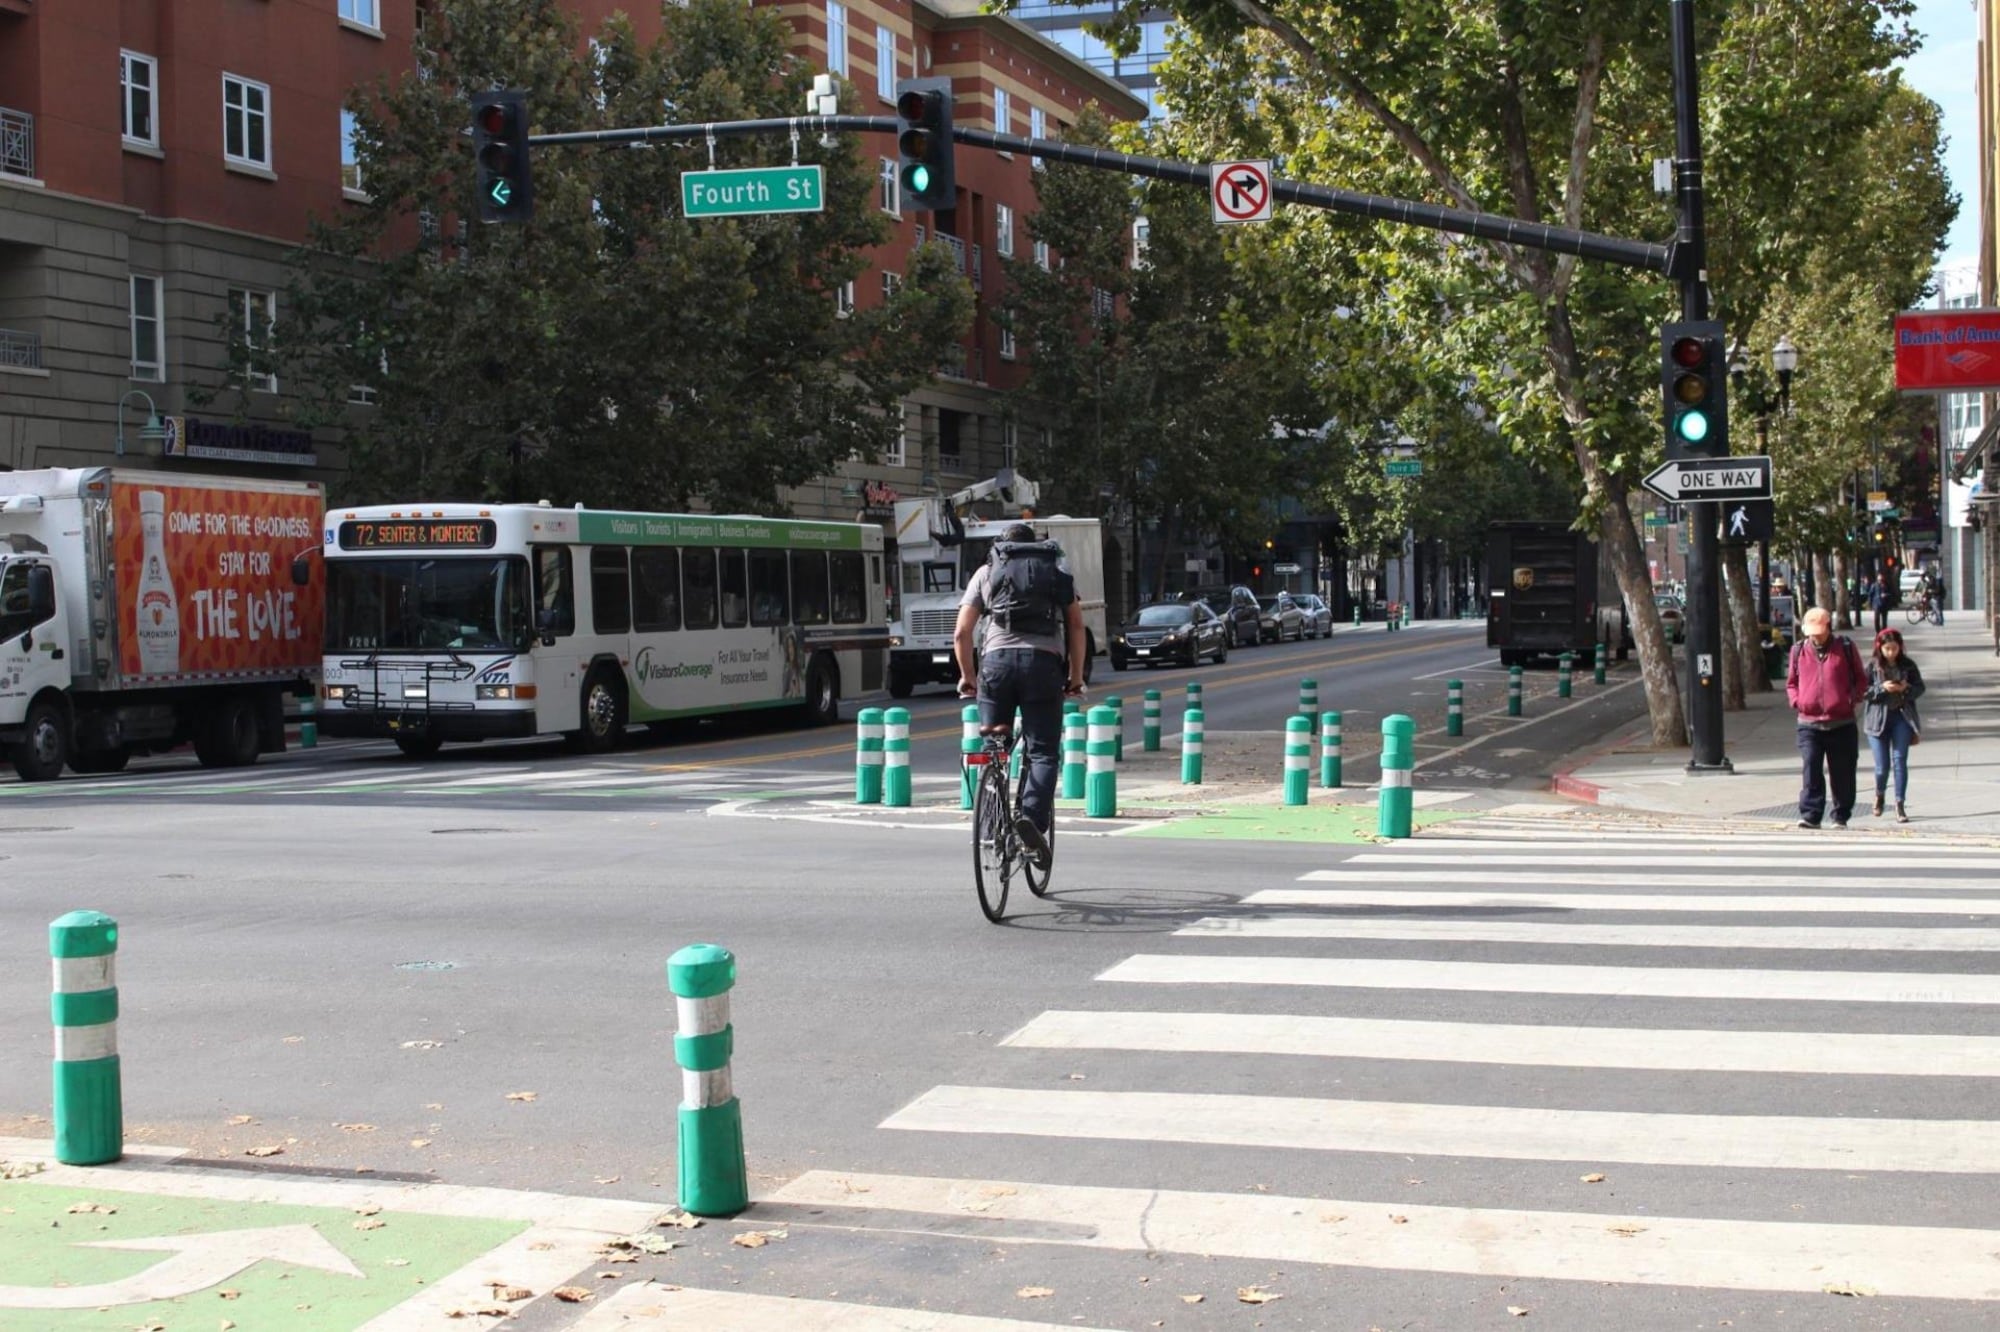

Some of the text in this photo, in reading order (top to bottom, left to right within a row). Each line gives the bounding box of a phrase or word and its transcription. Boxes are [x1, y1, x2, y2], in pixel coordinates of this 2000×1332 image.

[692, 177, 812, 205] Fourth St
[1900, 328, 1943, 345] Bank
[1944, 325, 1964, 344] of
[1680, 471, 1756, 488] ONE WAY
[169, 511, 201, 535] COME
[205, 512, 227, 535] FOR
[231, 514, 251, 536] THE
[254, 516, 312, 538] GOODNESS.
[356, 524, 483, 545] 72 SENTER & MONTEREY
[611, 519, 638, 535] Visitors
[645, 520, 671, 536] Tourists
[678, 521, 713, 539] Immigrants
[219, 551, 271, 577] STAY FOR
[190, 588, 301, 641] THE LOVE.
[718, 648, 769, 664] For All Your Travel
[481, 672, 510, 684] VTA
[649, 662, 713, 680] VisitorsCoverage
[720, 669, 768, 685] Insurance Needs
